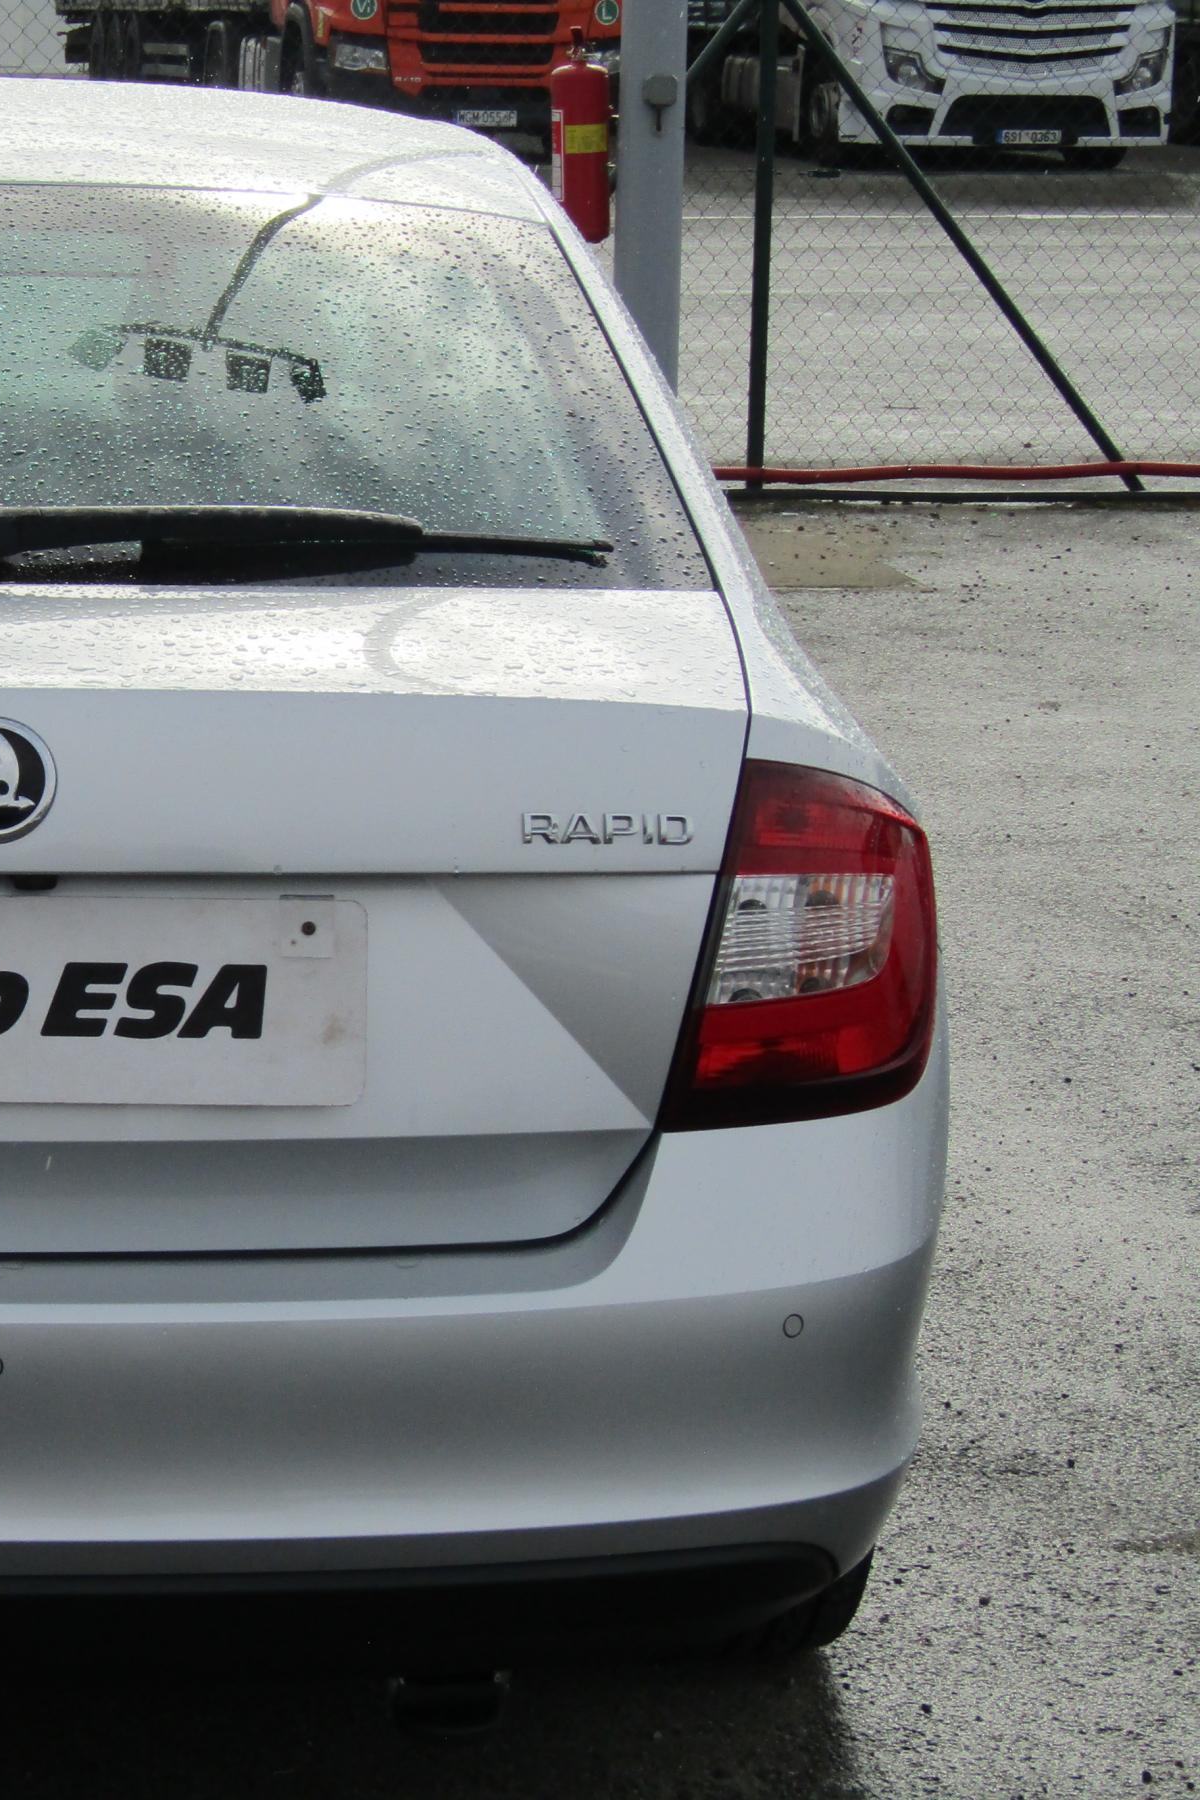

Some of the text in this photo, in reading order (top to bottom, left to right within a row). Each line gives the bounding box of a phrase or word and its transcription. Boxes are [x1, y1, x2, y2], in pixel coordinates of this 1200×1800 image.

[601, 2, 613, 20] L
[521, 812, 695, 845] RAPID
[40, 961, 268, 1040] ESA
